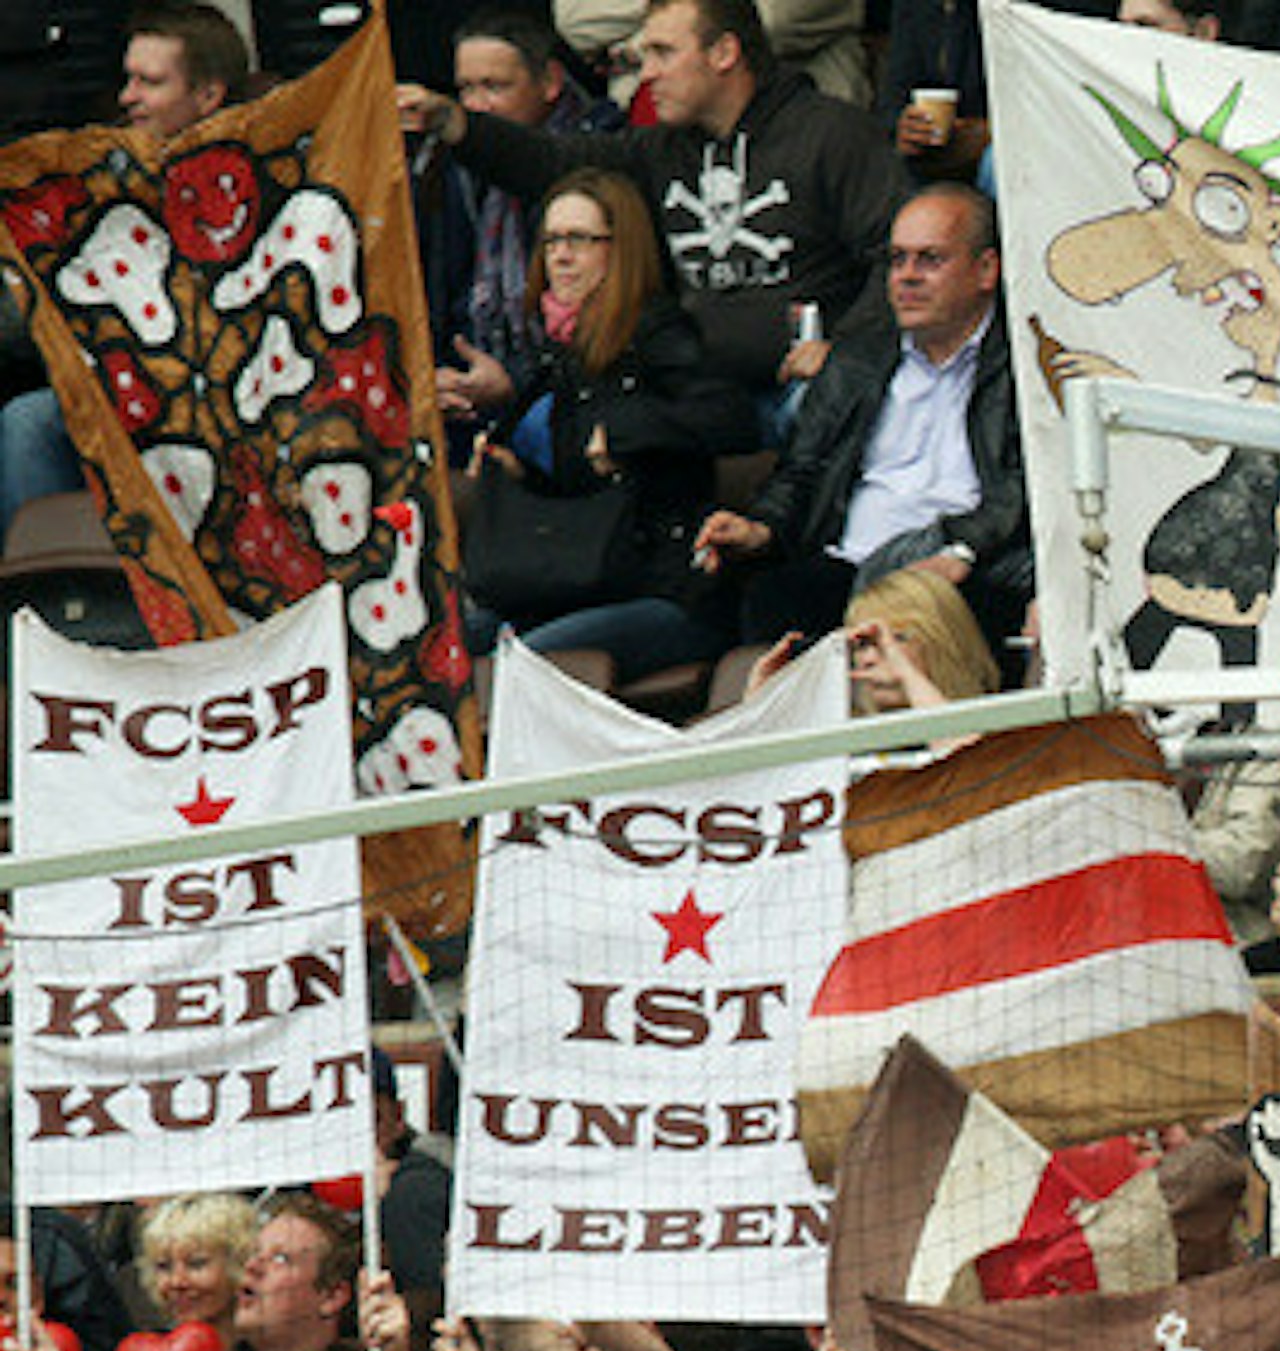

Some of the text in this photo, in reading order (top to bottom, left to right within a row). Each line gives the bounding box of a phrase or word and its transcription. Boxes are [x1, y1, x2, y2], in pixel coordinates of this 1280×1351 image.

[30, 667, 330, 759] FCSP
[496, 787, 836, 867] FCSP
[106, 854, 296, 930] IST
[34, 947, 347, 1039] KEIN
[561, 980, 788, 1050] IST
[25, 1052, 366, 1142] KULT
[472, 1093, 800, 1150] UNSE
[465, 1202, 833, 1254] LEBEN
